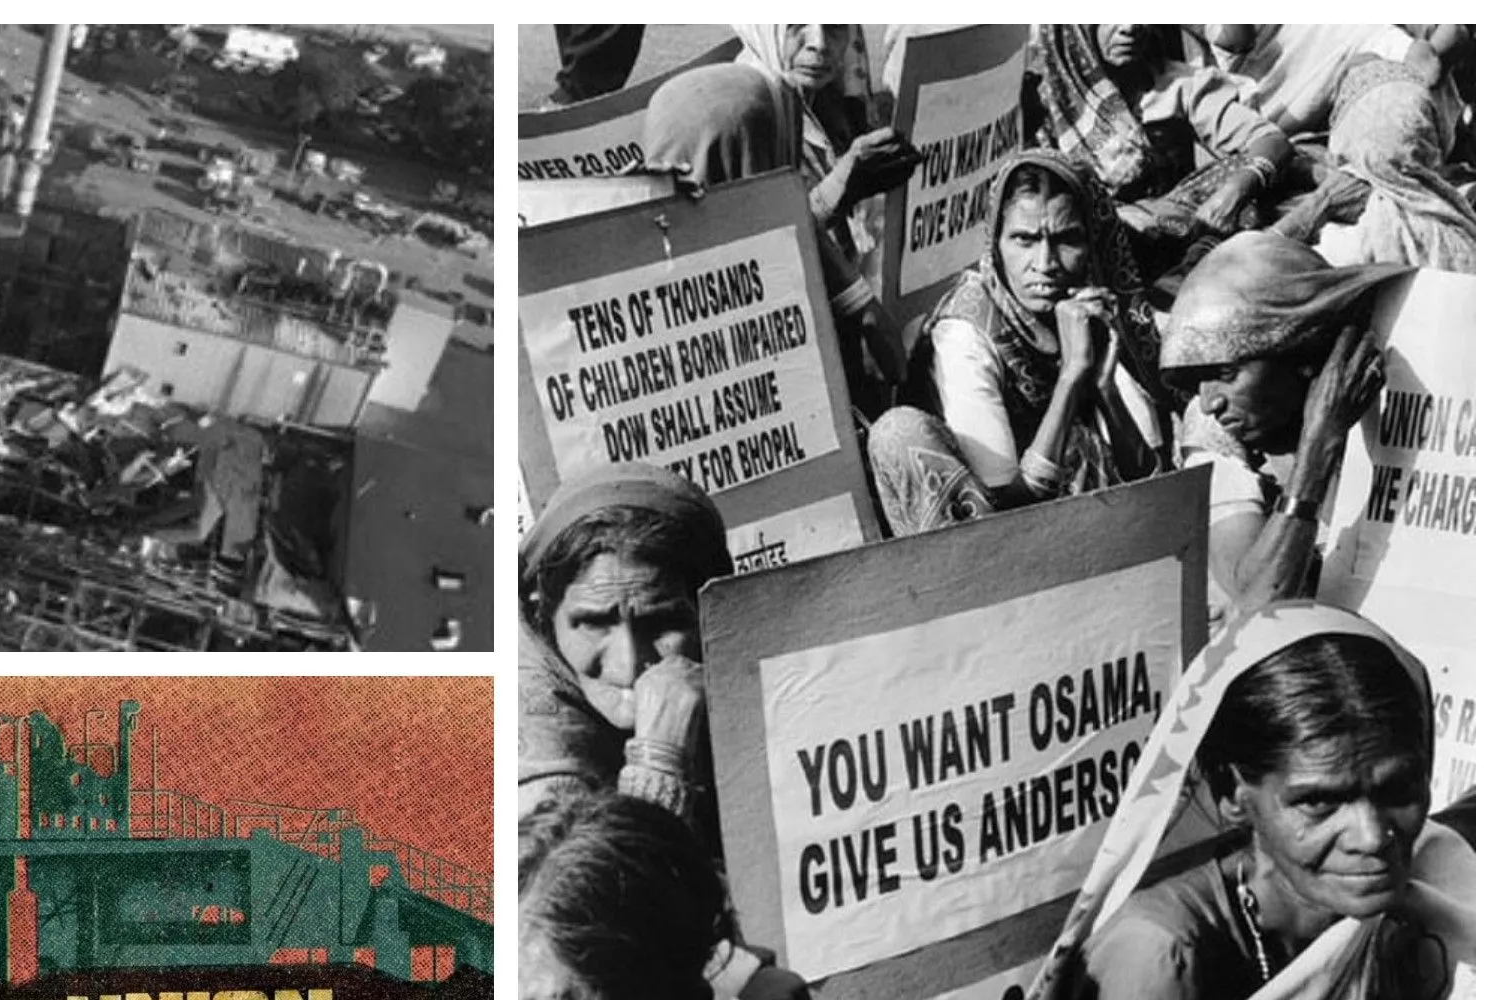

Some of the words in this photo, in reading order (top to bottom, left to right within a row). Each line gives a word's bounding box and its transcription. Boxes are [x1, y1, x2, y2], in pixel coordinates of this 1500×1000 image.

[518, 158, 576, 180] OVER
[573, 142, 644, 177] 20,000
[567, 298, 627, 353] TENS
[628, 290, 654, 337] OF
[655, 259, 764, 329] THOUSANDS
[546, 373, 575, 421] OF
[578, 345, 677, 412] CHILDREN
[676, 329, 730, 383] BORN
[729, 304, 807, 368] IMPAIRED
[602, 412, 649, 463] DOW
[650, 395, 711, 451] SHALL
[712, 370, 782, 433] ASSUME
[698, 438, 738, 493] FOR
[737, 422, 806, 480] BHOPAL
[1380, 390, 1453, 453] UNION
[1404, 469, 1477, 535] CHARG
[797, 730, 887, 816] YOU
[900, 692, 1015, 790] WANT
[1029, 651, 1161, 752] OSAMA,
[800, 823, 900, 914] GIVE
[912, 803, 965, 881] US
[980, 737, 1150, 864] ANDERSO
